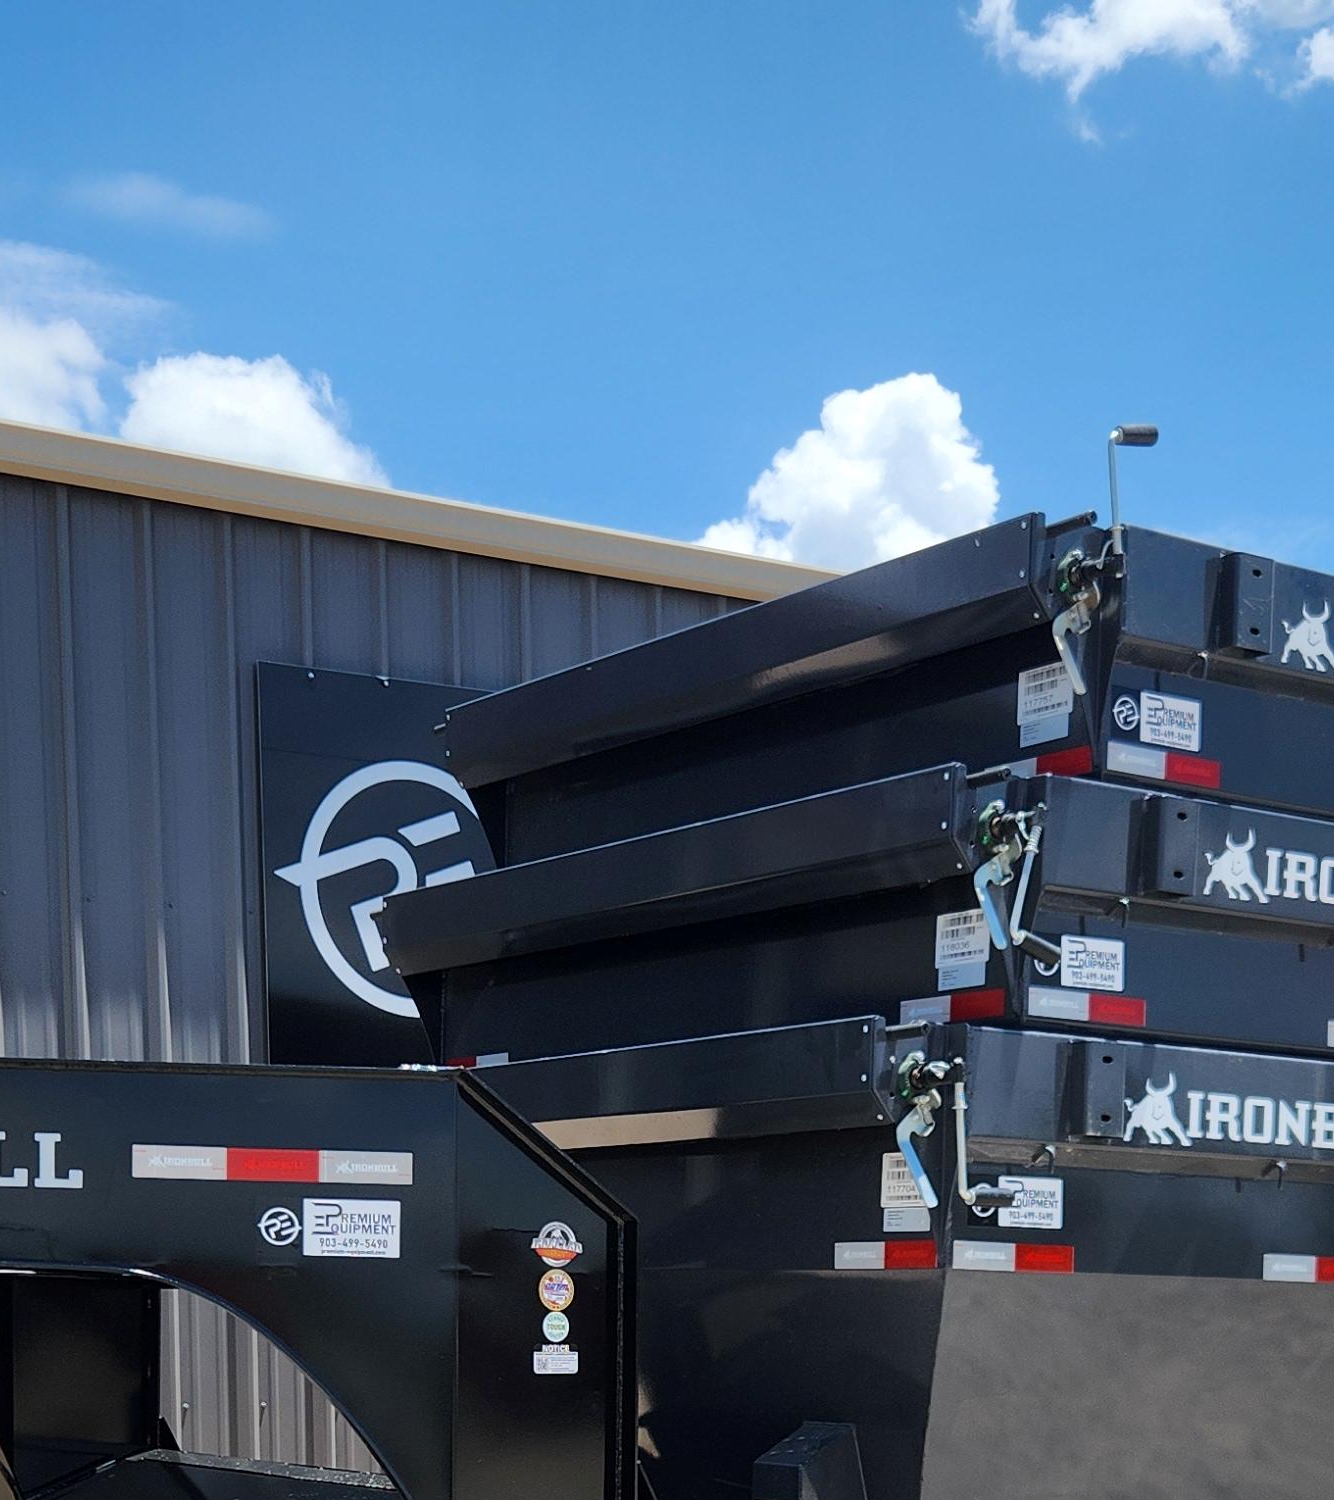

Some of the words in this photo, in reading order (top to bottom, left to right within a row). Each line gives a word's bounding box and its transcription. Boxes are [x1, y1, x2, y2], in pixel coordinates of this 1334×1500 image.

[312, 1215, 397, 1236] EQUIPMENT
[319, 1237, 389, 1249] 903-499-5490
[542, 1344, 570, 1353] NOTICE
